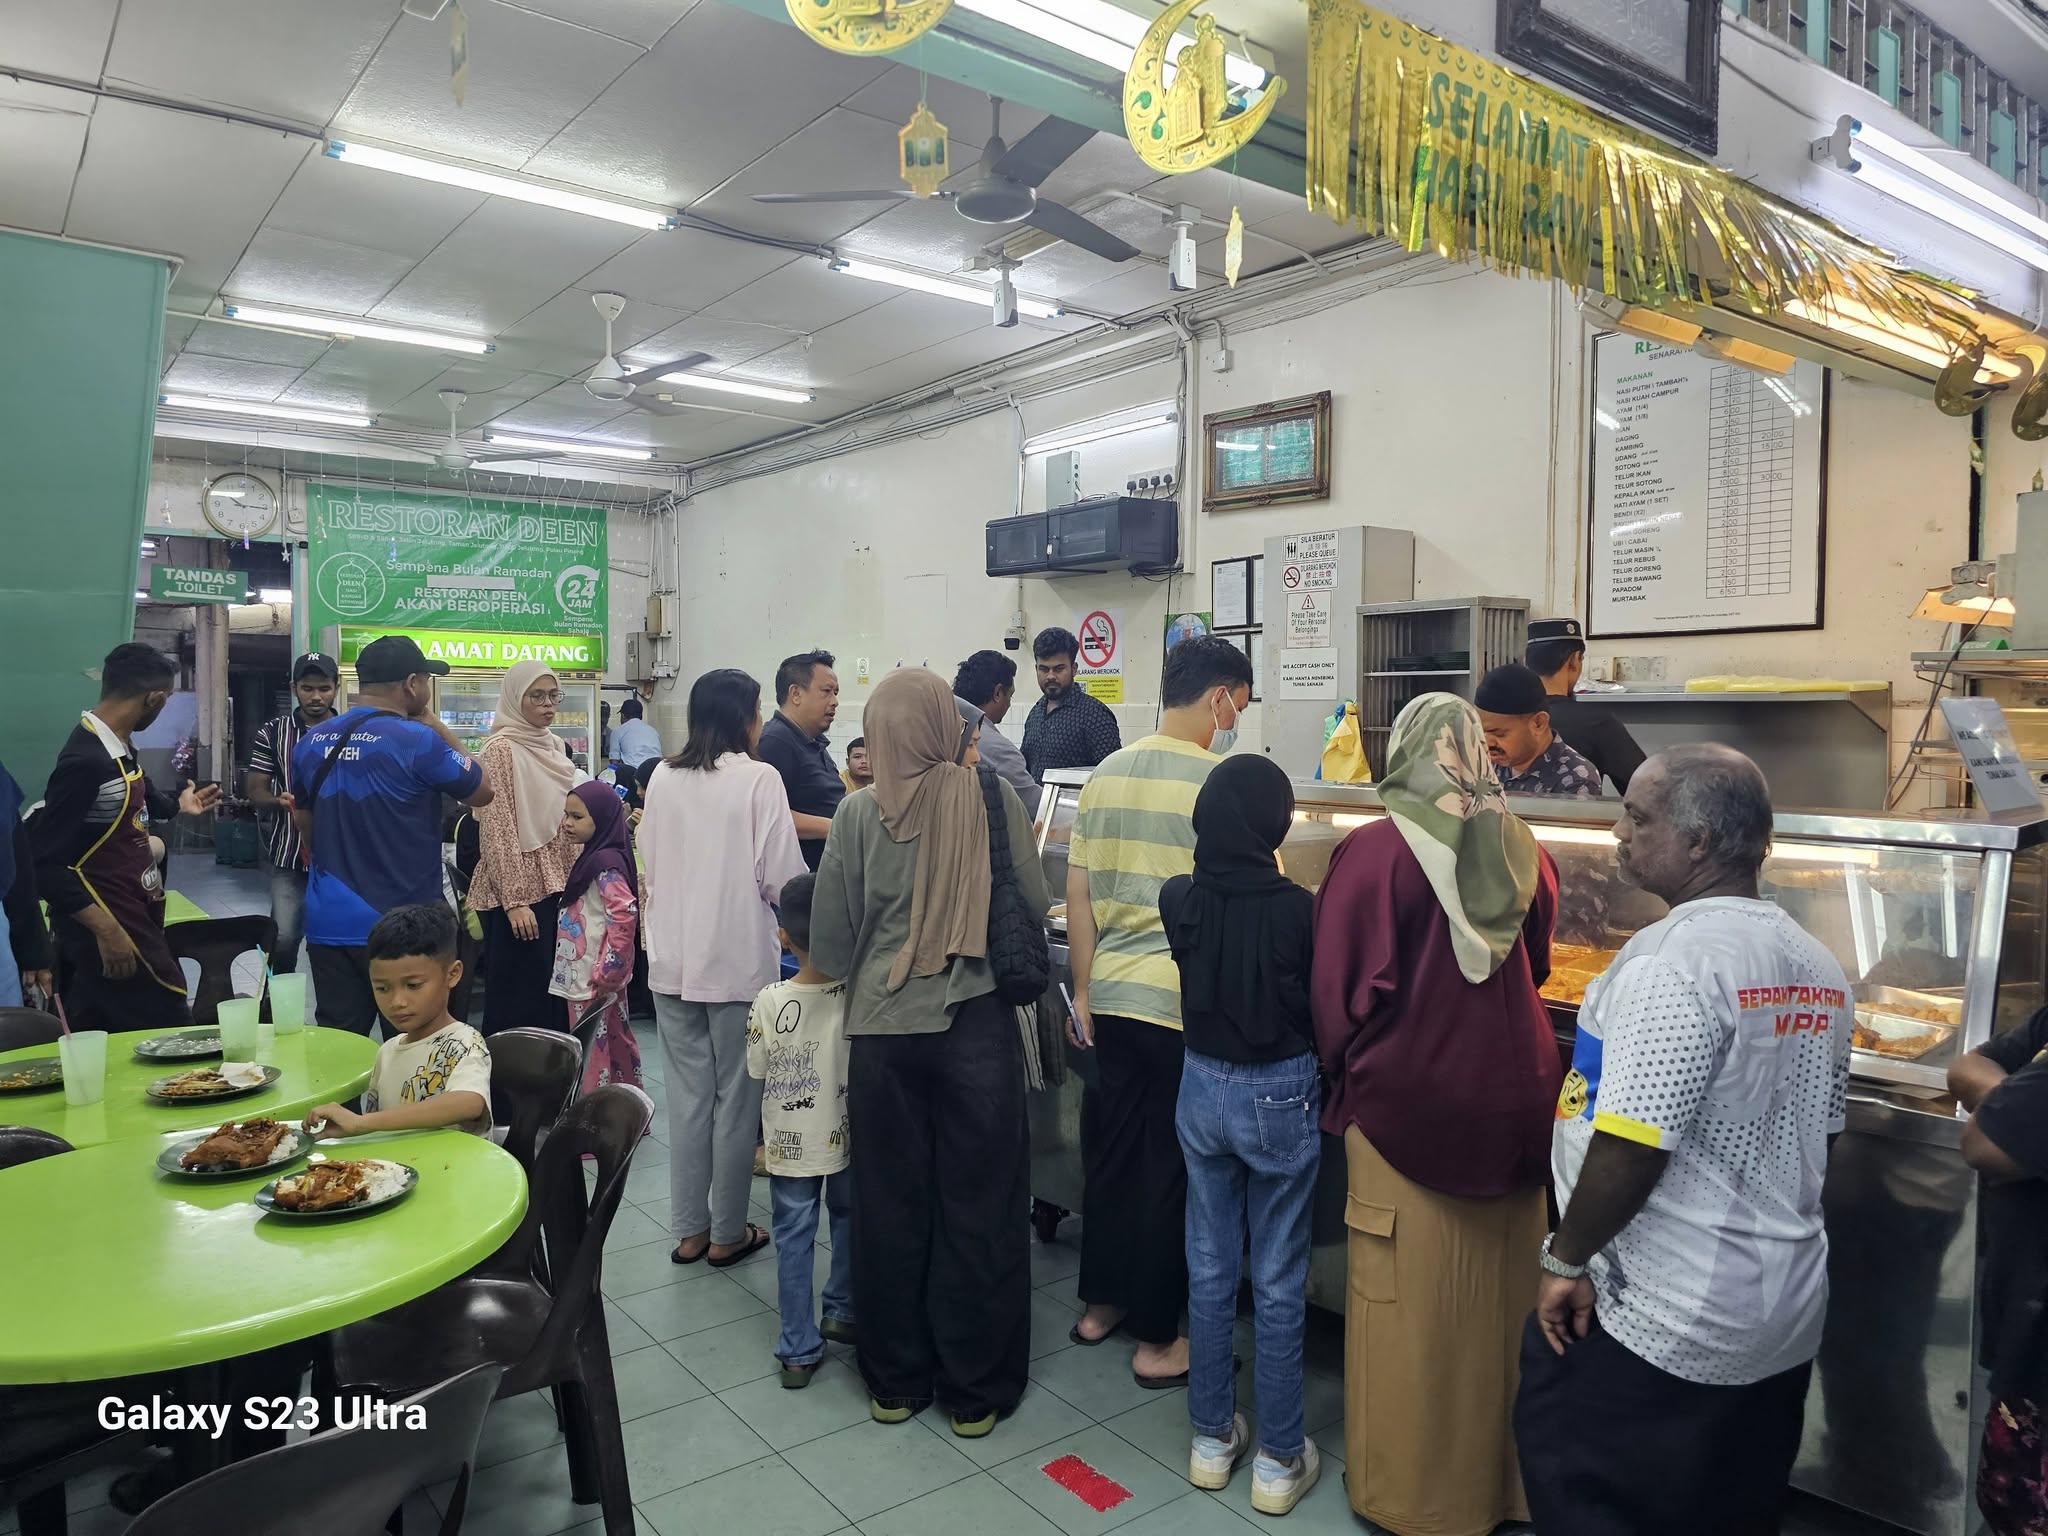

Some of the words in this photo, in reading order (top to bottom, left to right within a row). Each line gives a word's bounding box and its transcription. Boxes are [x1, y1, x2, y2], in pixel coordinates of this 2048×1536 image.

[1428, 72, 1591, 182] SELAMAT
[1617, 371, 1653, 384] MAKANAN
[1616, 387, 1631, 395] NASI
[1632, 383, 1651, 392] PUTIH
[1616, 397, 1631, 405] NASI
[1632, 394, 1650, 403] KUAH
[1651, 388, 1679, 398] CAMPUR
[1616, 406, 1633, 414] AYAM
[1616, 434, 1640, 443] DAGING
[1615, 443, 1644, 452] KAMBING
[1615, 453, 1637, 462] UDANG
[1615, 463, 1641, 471] SOTONG
[1636, 478, 1662, 487] SOTONG
[1640, 489, 1655, 497] IKAN
[328, 500, 510, 541] RESTORAN
[518, 516, 598, 547] DEEN
[1633, 527, 1660, 535] GORENG
[1313, 533, 1335, 542] BERATUR
[1300, 550, 1318, 559] PLEASE
[1319, 549, 1336, 557] QUEUE
[386, 560, 449, 575] Sempena
[453, 562, 490, 576] Bulan
[494, 566, 552, 578] Ramadan
[163, 568, 236, 585] TANDAS
[1312, 578, 1332, 587] SMOKING
[176, 582, 224, 594] TOILET
[566, 580, 596, 599] 24
[414, 588, 488, 600] RESTORAN
[492, 590, 527, 601] DEEN
[394, 598, 442, 610] AKAN
[448, 600, 544, 614] BEROPERASI
[568, 599, 592, 608] JAM
[502, 643, 589, 662] DATANG
[311, 732, 330, 744] For
[1774, 1012, 1829, 1038] MPP
